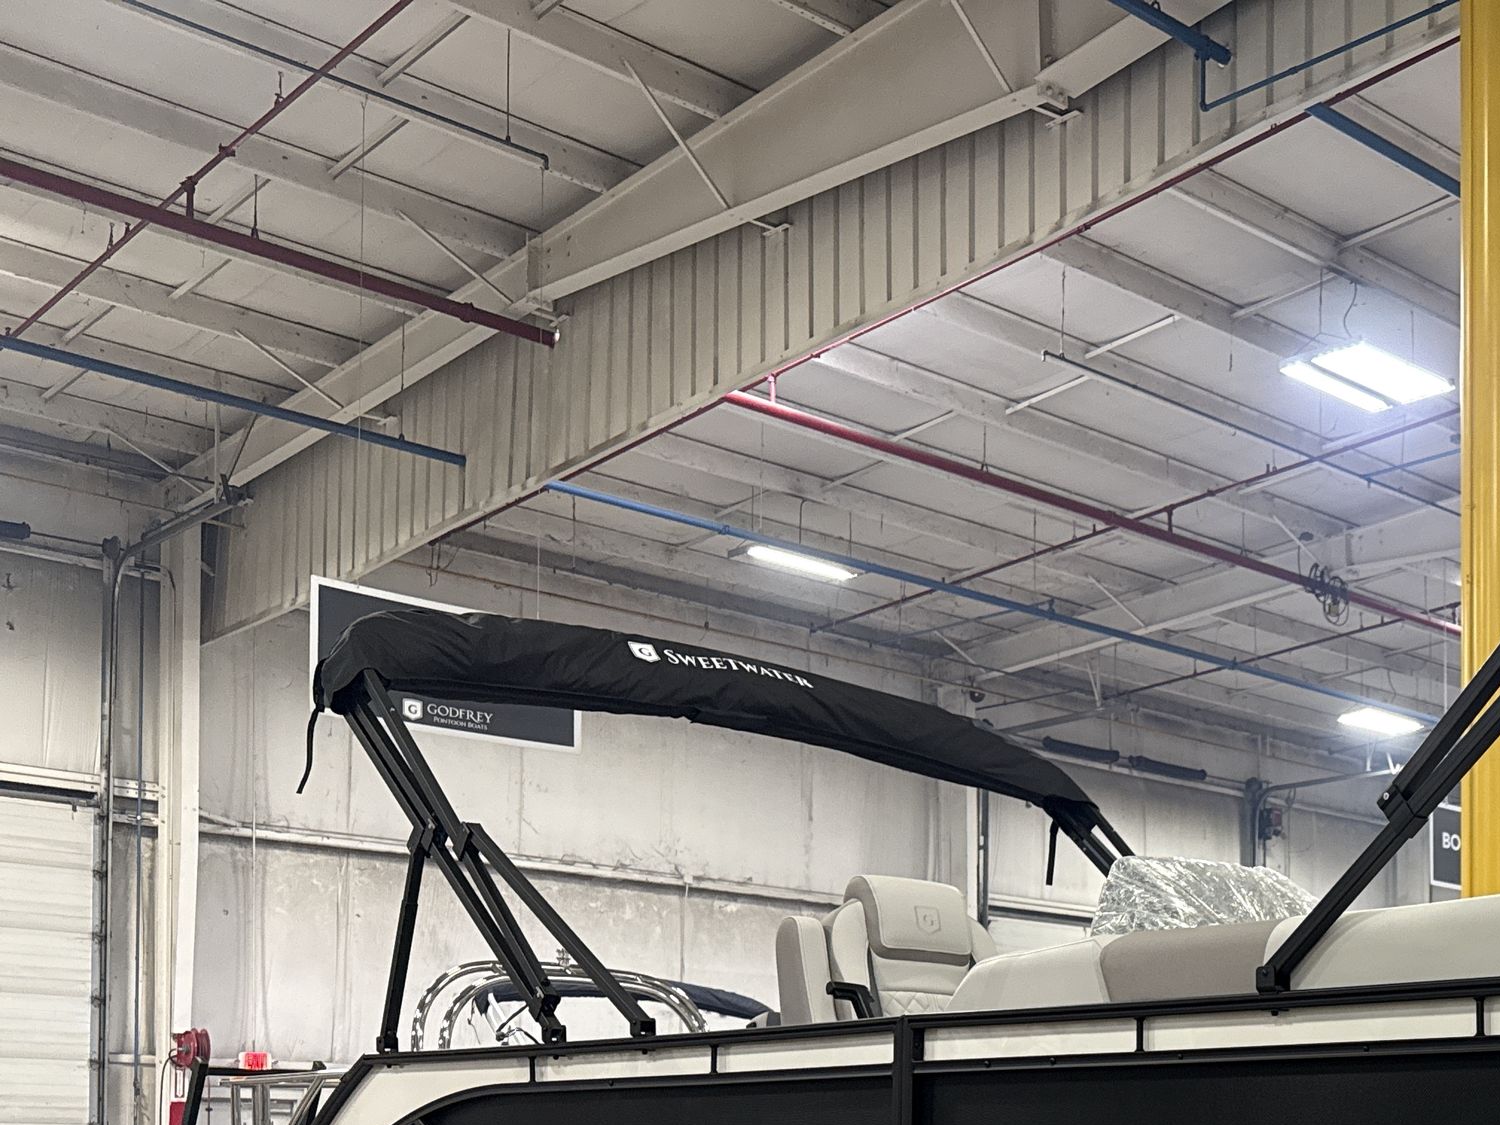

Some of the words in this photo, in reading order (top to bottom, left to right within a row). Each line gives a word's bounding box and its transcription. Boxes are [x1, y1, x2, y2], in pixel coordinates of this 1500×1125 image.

[663, 649, 814, 688] SWEETWATER
[427, 703, 493, 724] GODFREY
[433, 716, 467, 728] PONTOON
[467, 721, 488, 731] BOATS
